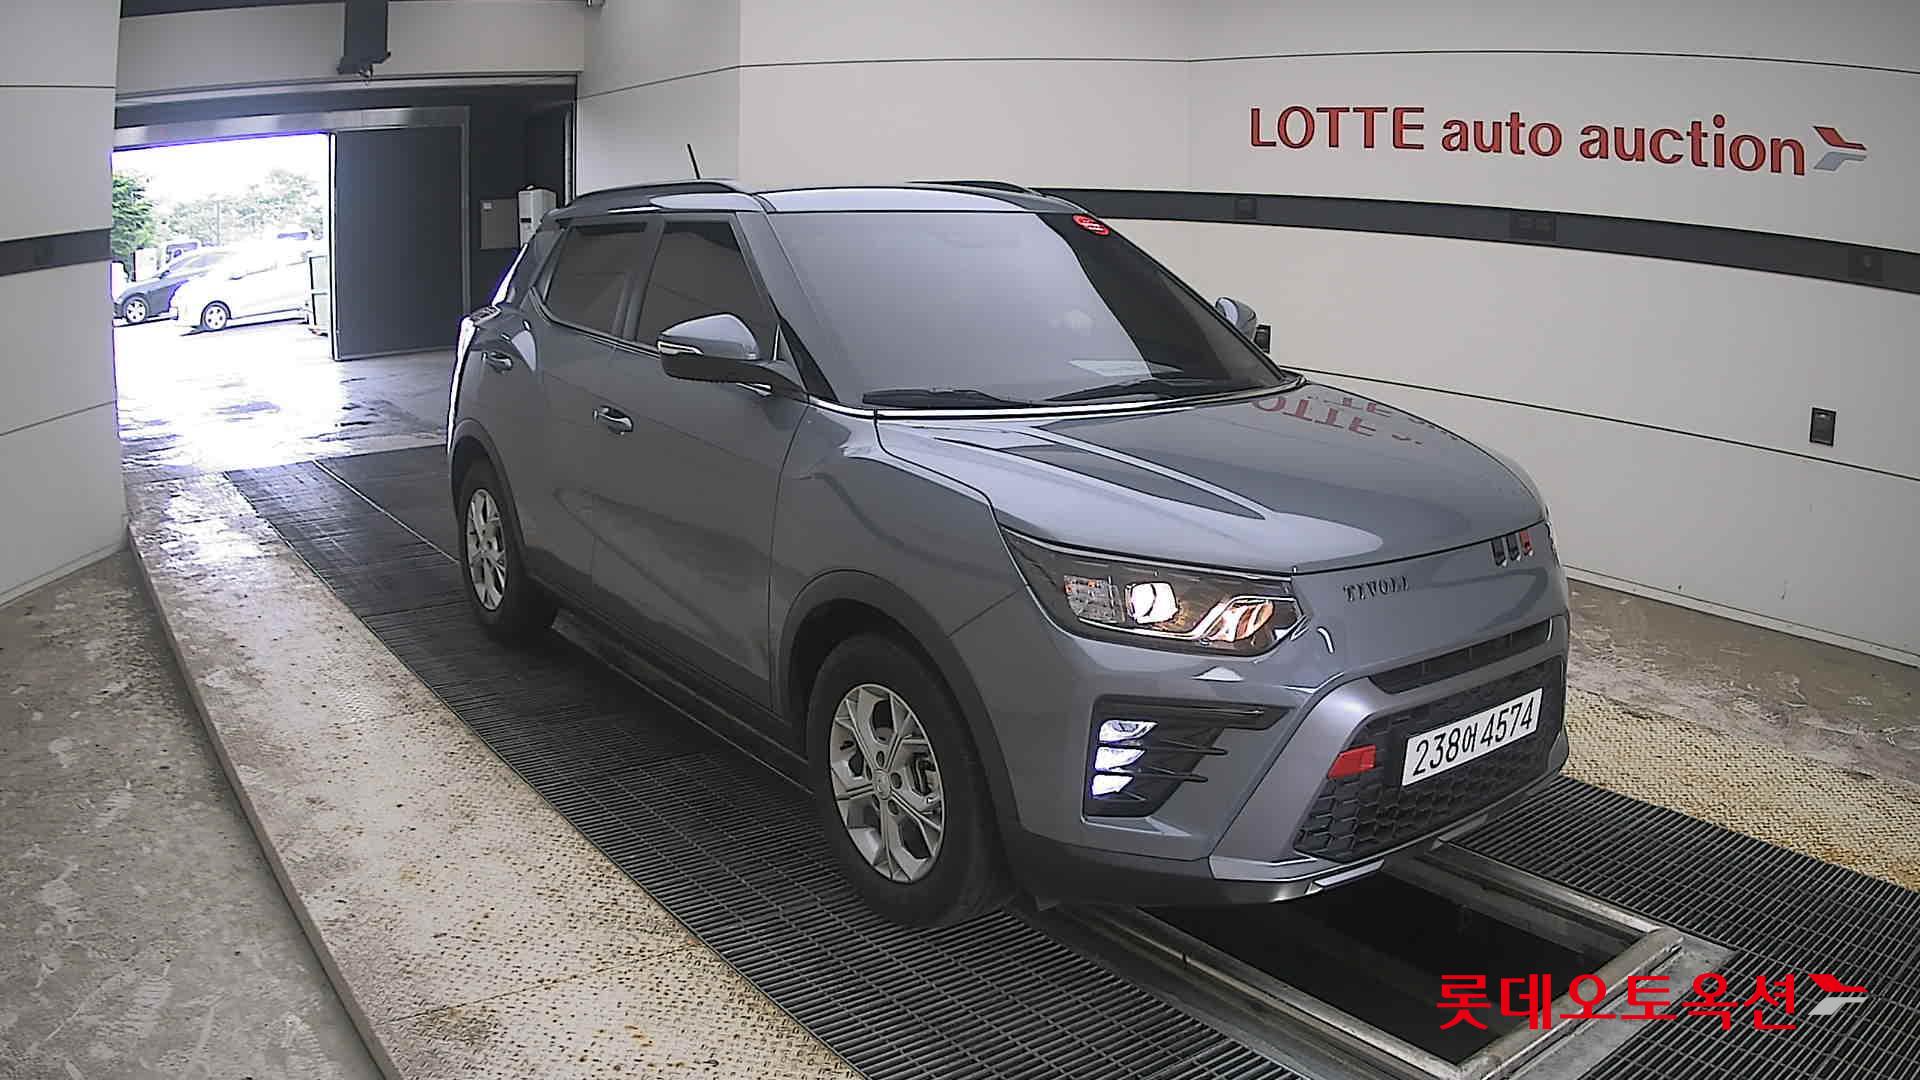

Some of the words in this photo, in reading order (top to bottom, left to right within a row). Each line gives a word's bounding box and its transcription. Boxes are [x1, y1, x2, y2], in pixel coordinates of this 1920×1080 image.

[1250, 106, 1425, 150] LOTTE
[1441, 111, 1563, 158] auto
[1579, 114, 1806, 176] auction
